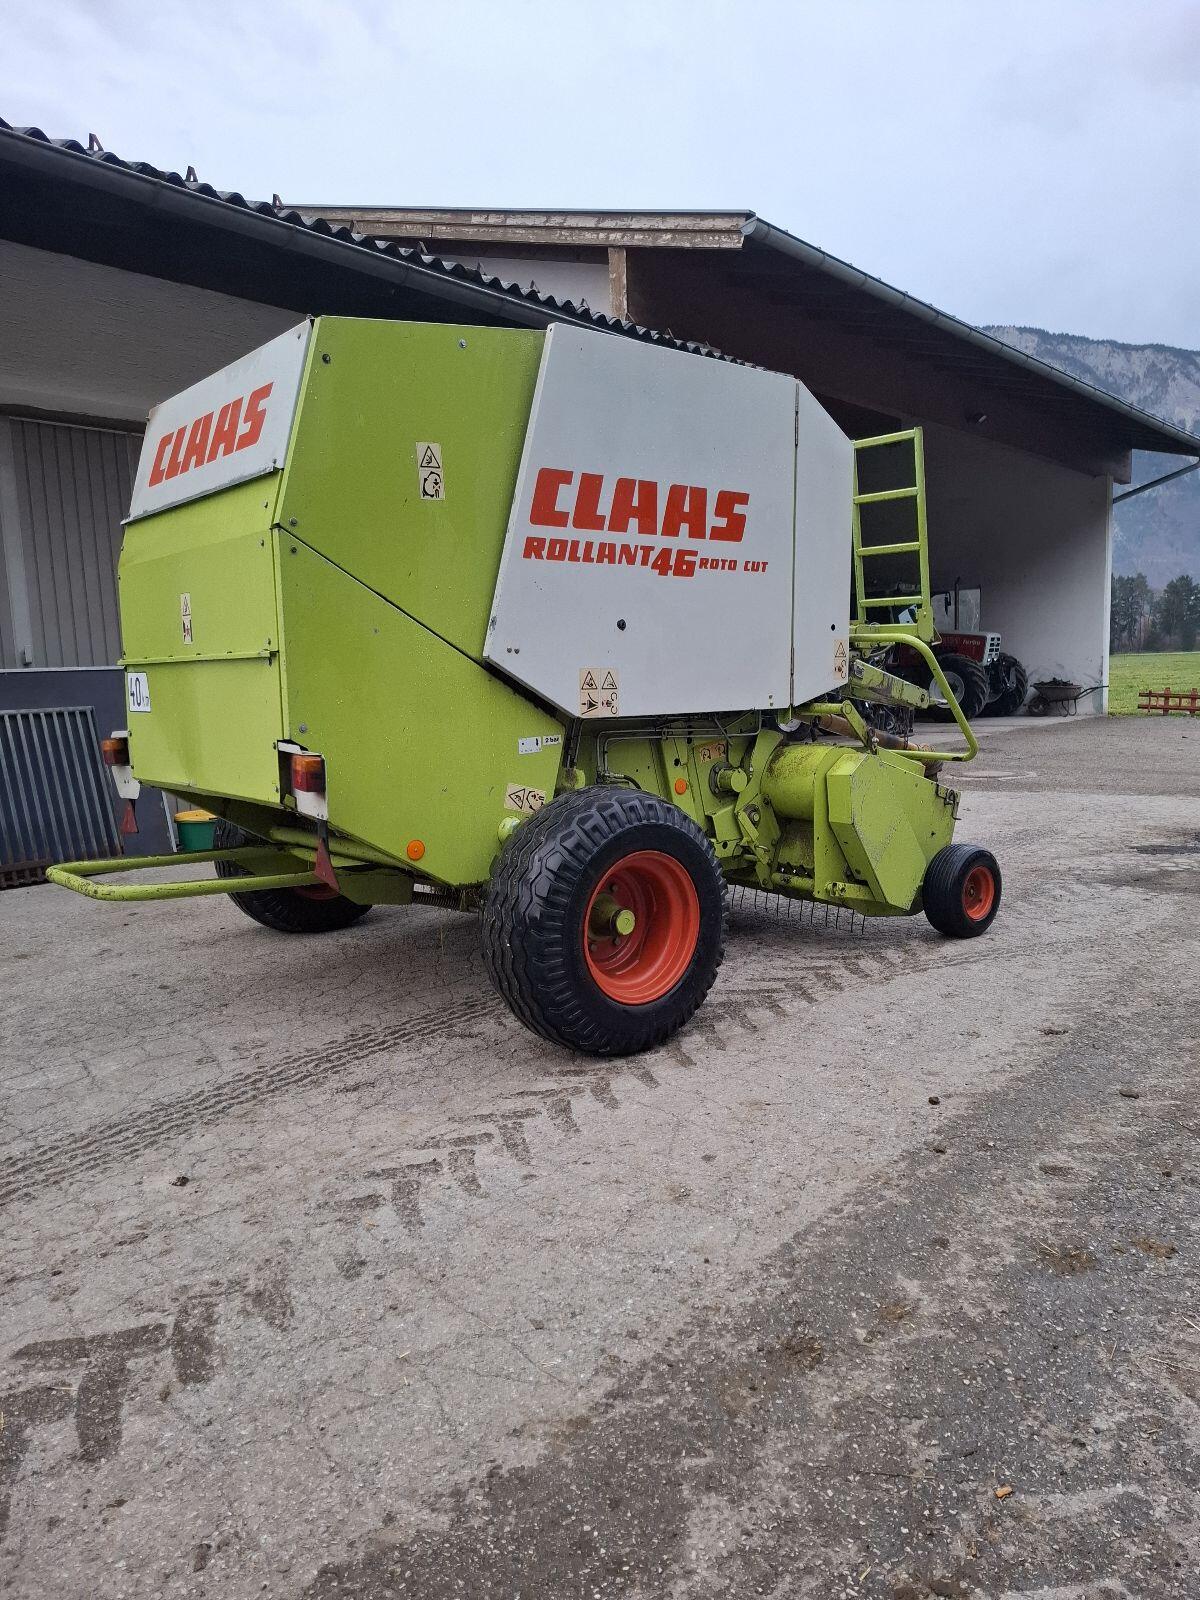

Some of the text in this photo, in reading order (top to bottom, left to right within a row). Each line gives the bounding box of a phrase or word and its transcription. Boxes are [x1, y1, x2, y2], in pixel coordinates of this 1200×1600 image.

[149, 382, 273, 488] CLAAS
[530, 467, 750, 543] CLAAS
[699, 557, 738, 571] ROTO
[744, 560, 769, 573] CUT
[130, 677, 142, 707] 40
